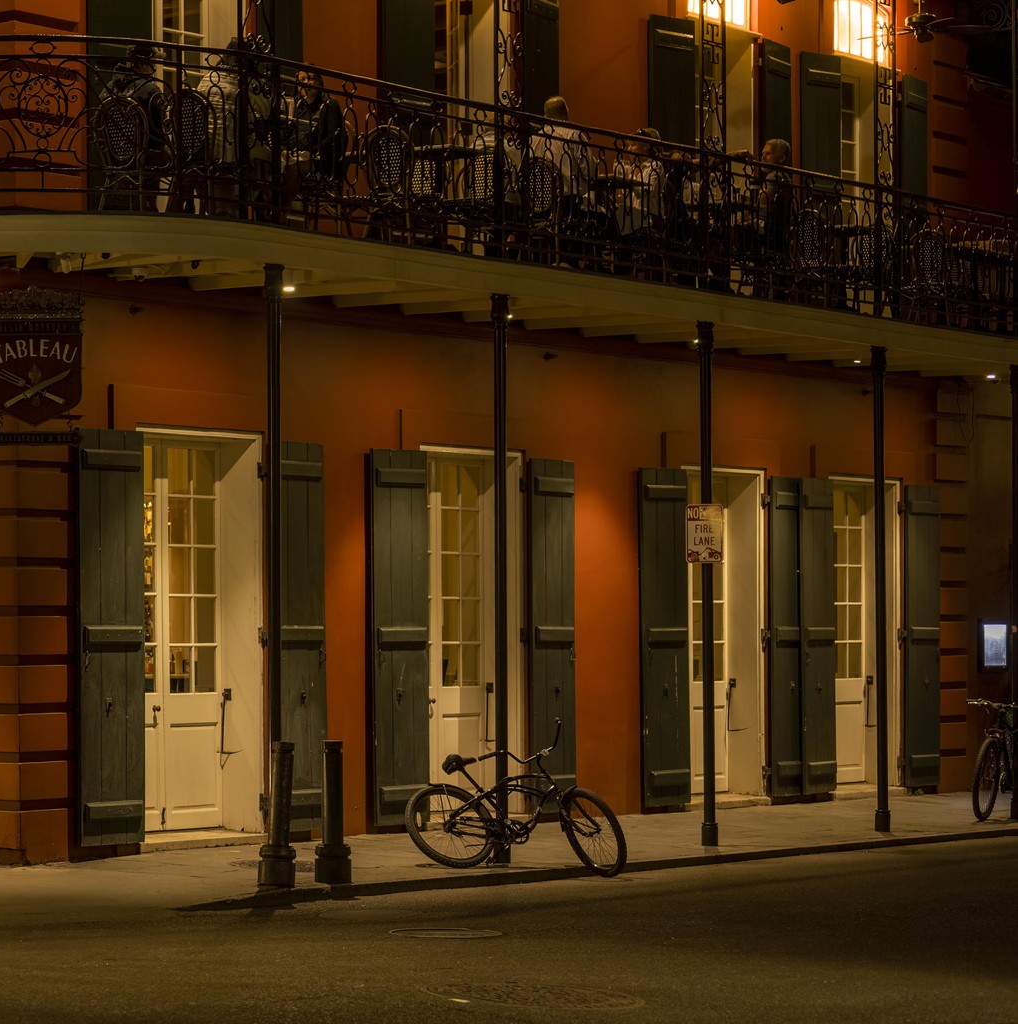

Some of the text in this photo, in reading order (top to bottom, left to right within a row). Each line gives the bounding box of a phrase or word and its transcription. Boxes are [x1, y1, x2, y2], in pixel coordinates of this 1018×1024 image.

[687, 507, 699, 519] NO
[694, 524, 714, 534] FIRE
[693, 536, 716, 546] LANE
